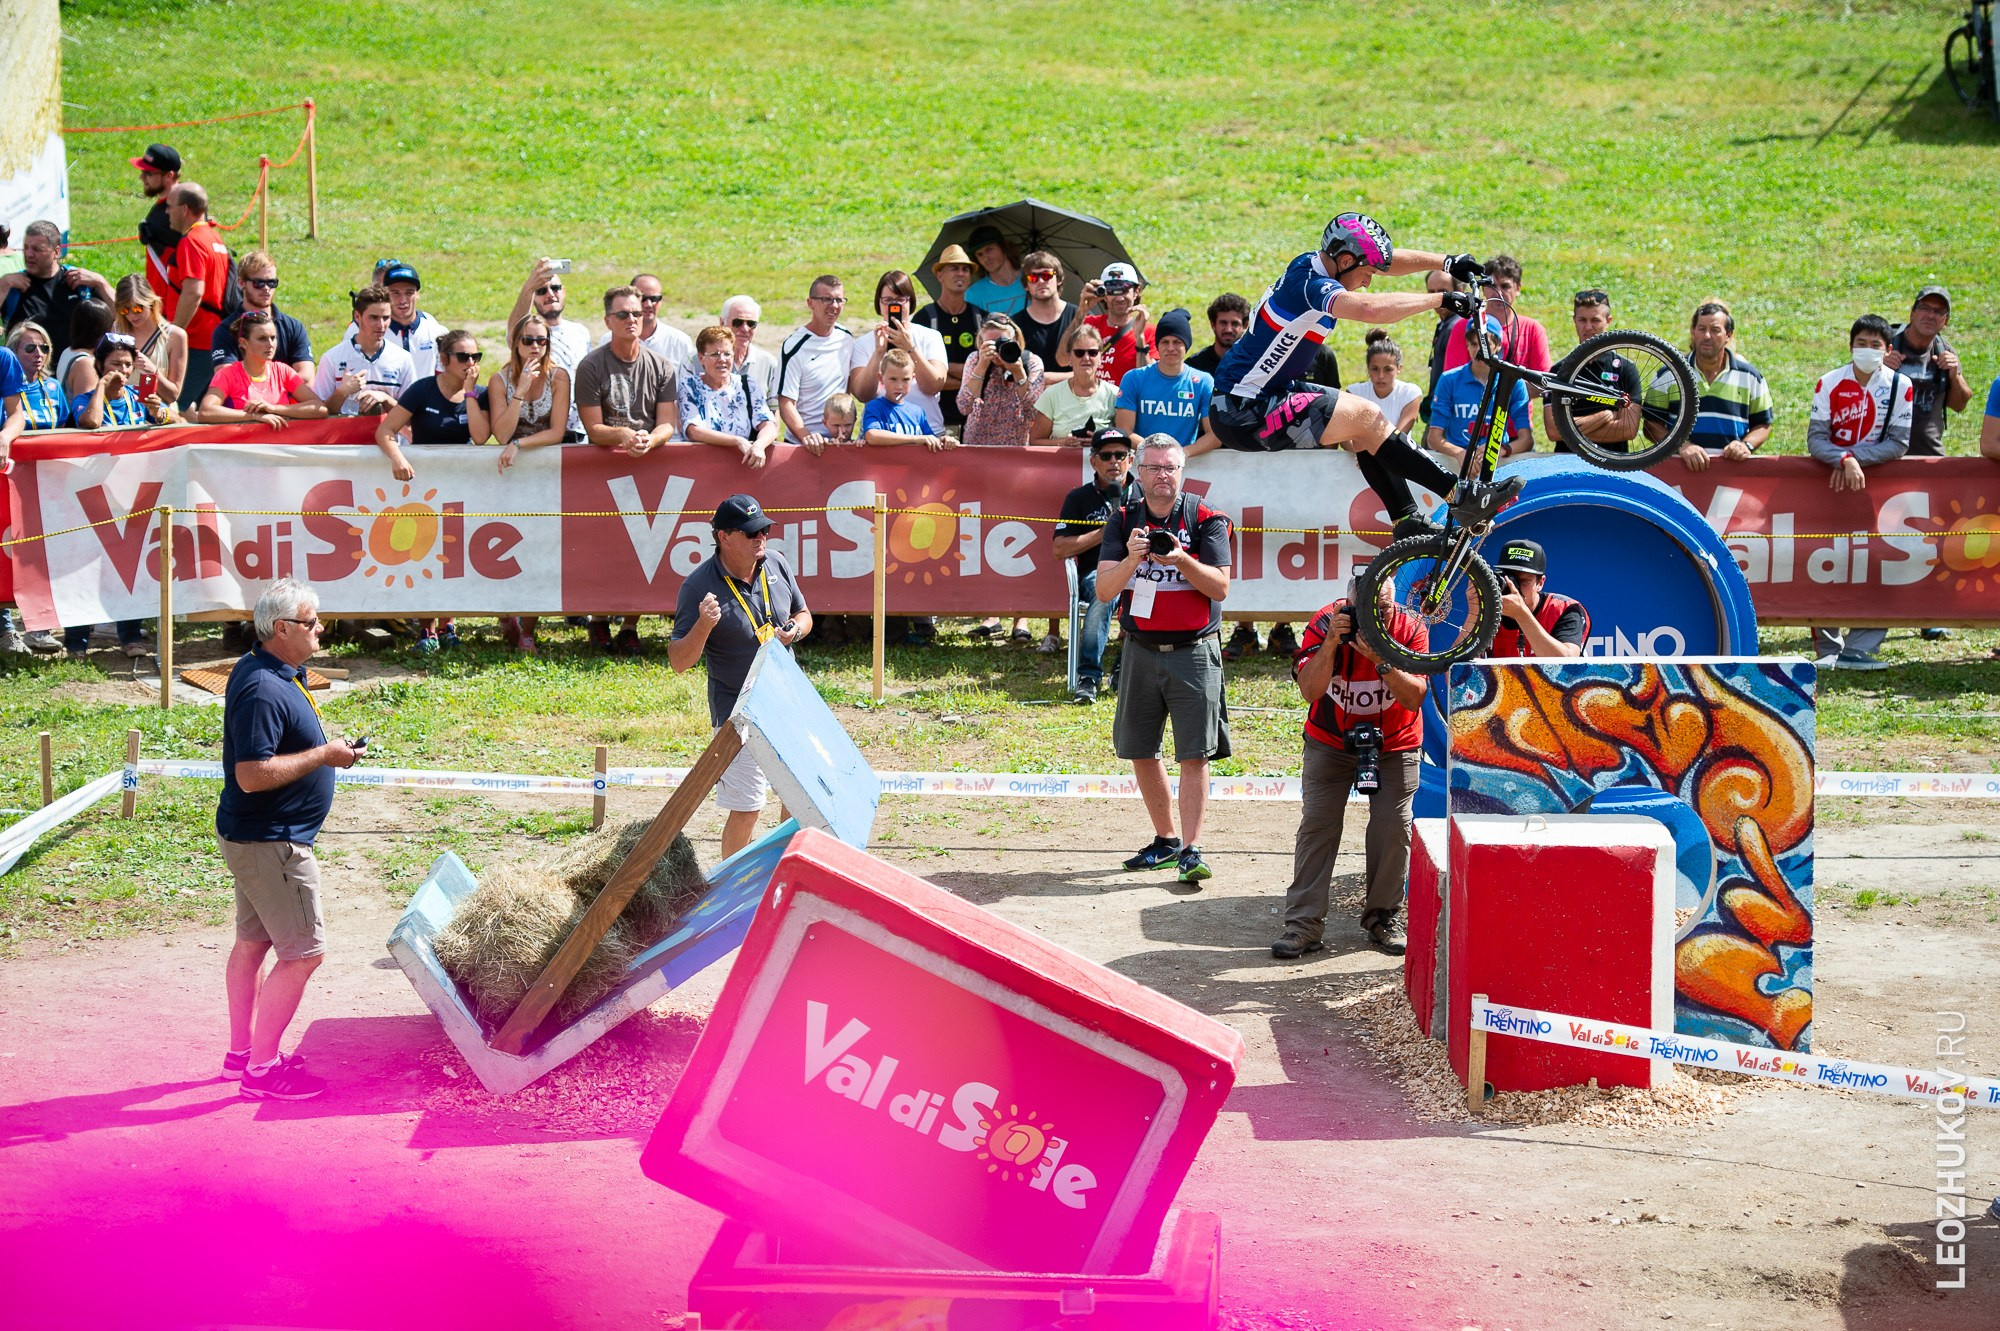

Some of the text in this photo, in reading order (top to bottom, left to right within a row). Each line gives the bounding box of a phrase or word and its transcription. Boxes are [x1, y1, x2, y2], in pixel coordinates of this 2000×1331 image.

[1259, 332, 1299, 375] FRANCE
[1140, 399, 1195, 418] ITALIA
[75, 479, 524, 596] Val di Sole
[606, 474, 1039, 586] Va di Sole
[1806, 530, 1869, 585] di
[1483, 1008, 1552, 1036] TRENTINO
[1568, 1021, 1592, 1043] Val
[1592, 1033, 1604, 1045] di
[1603, 1029, 1640, 1051] Sole
[1649, 1036, 1719, 1064] TRENTINO
[1735, 1049, 1759, 1071] Val
[1758, 1060, 1771, 1072] di
[1770, 1055, 1808, 1078] Sole
[1817, 1062, 1888, 1089] TRENTINO
[1904, 1074, 1929, 1095] Val
[803, 999, 1098, 1210] Val di Sole
